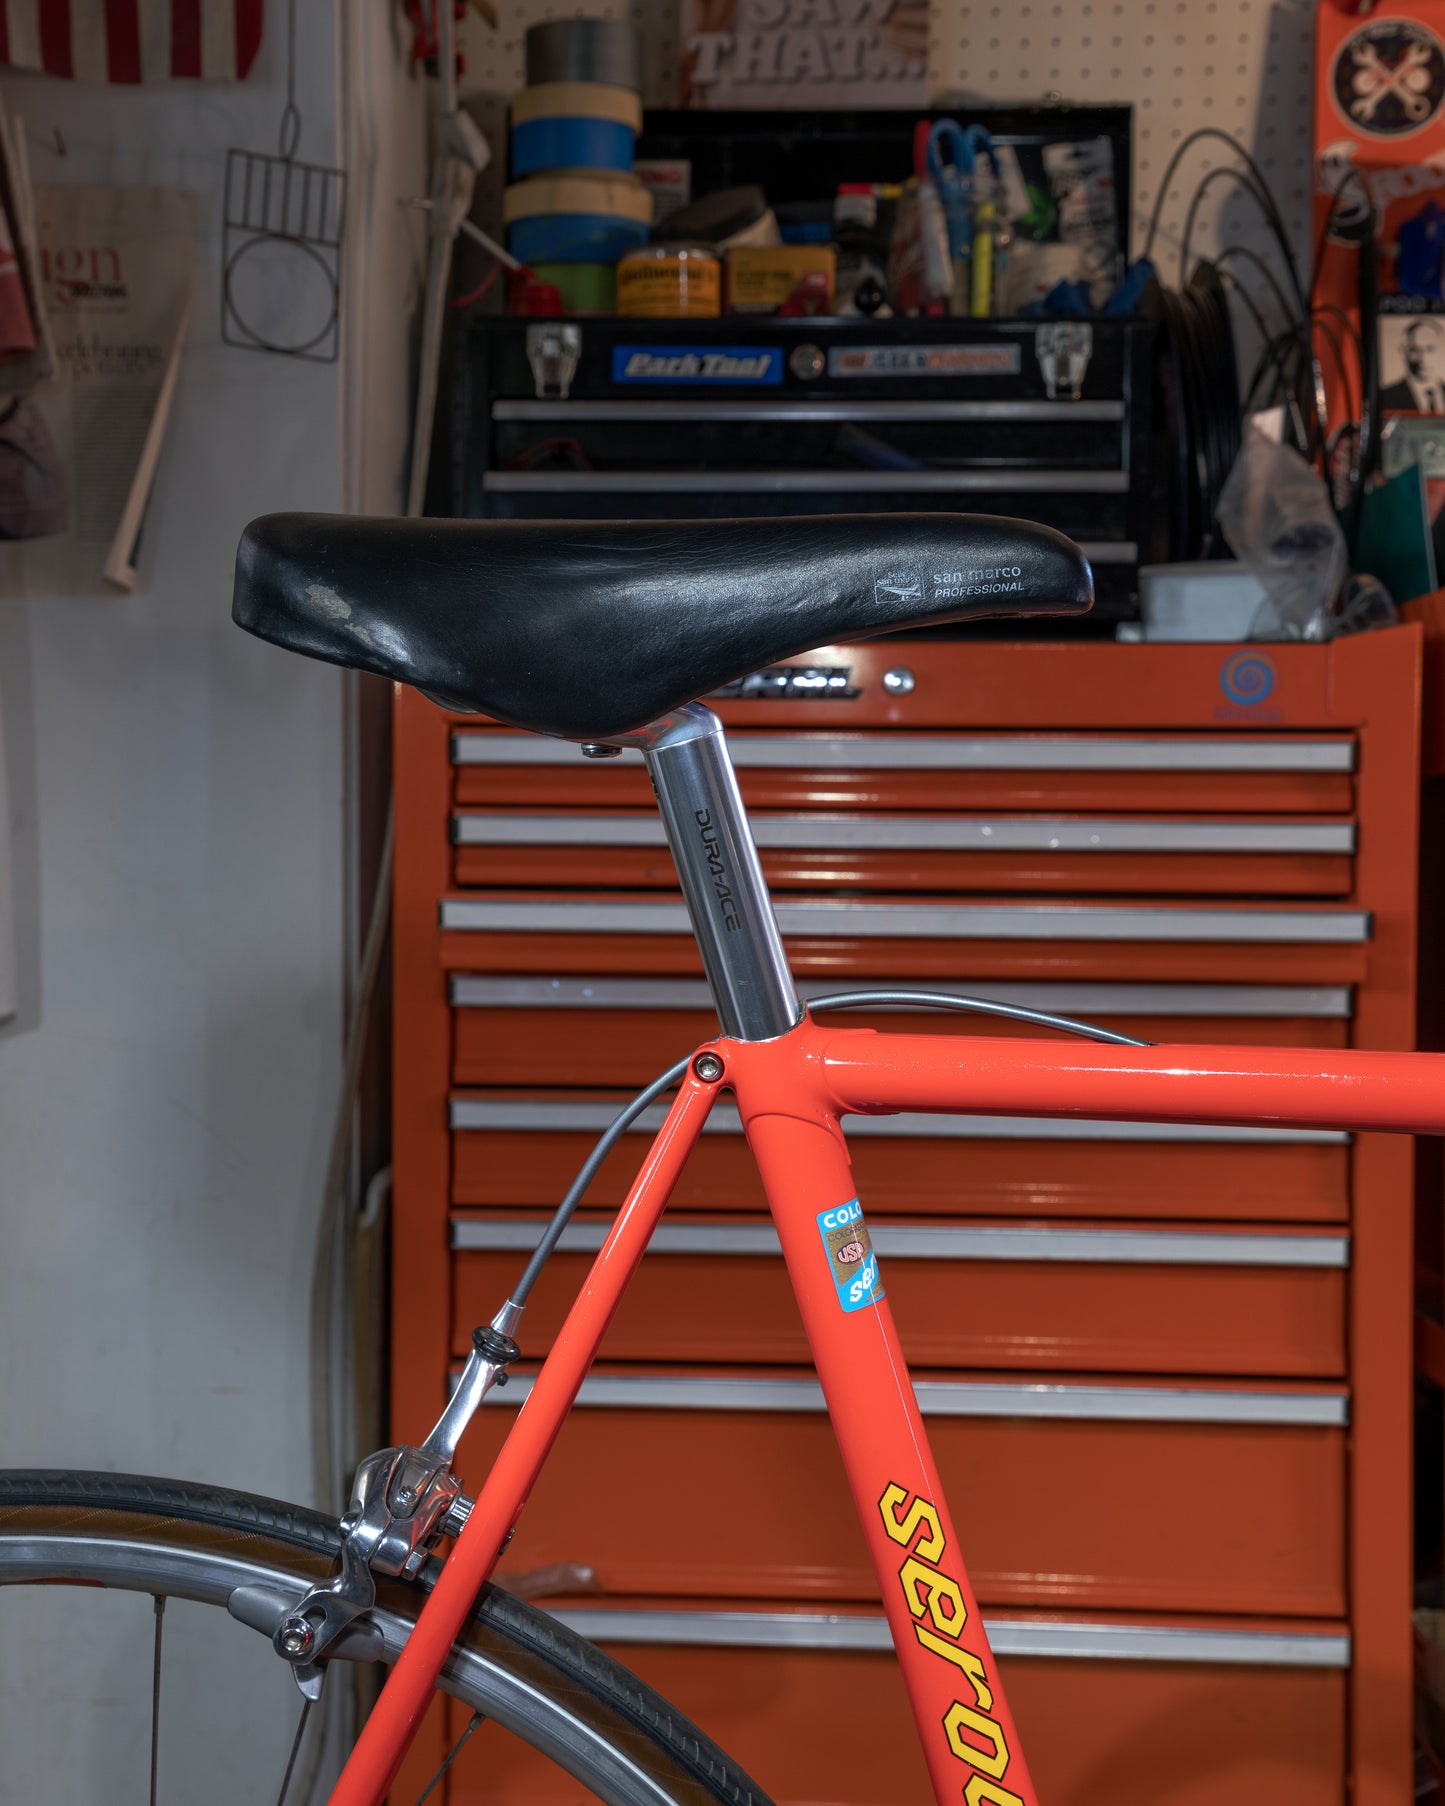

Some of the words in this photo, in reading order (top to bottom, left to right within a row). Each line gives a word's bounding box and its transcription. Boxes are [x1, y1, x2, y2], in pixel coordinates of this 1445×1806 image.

[41, 221, 122, 305] ign
[934, 572, 963, 584] san
[968, 566, 1021, 581] marco
[934, 582, 1025, 598] PROFESSIONAL
[694, 808, 742, 932] DURA-ACE
